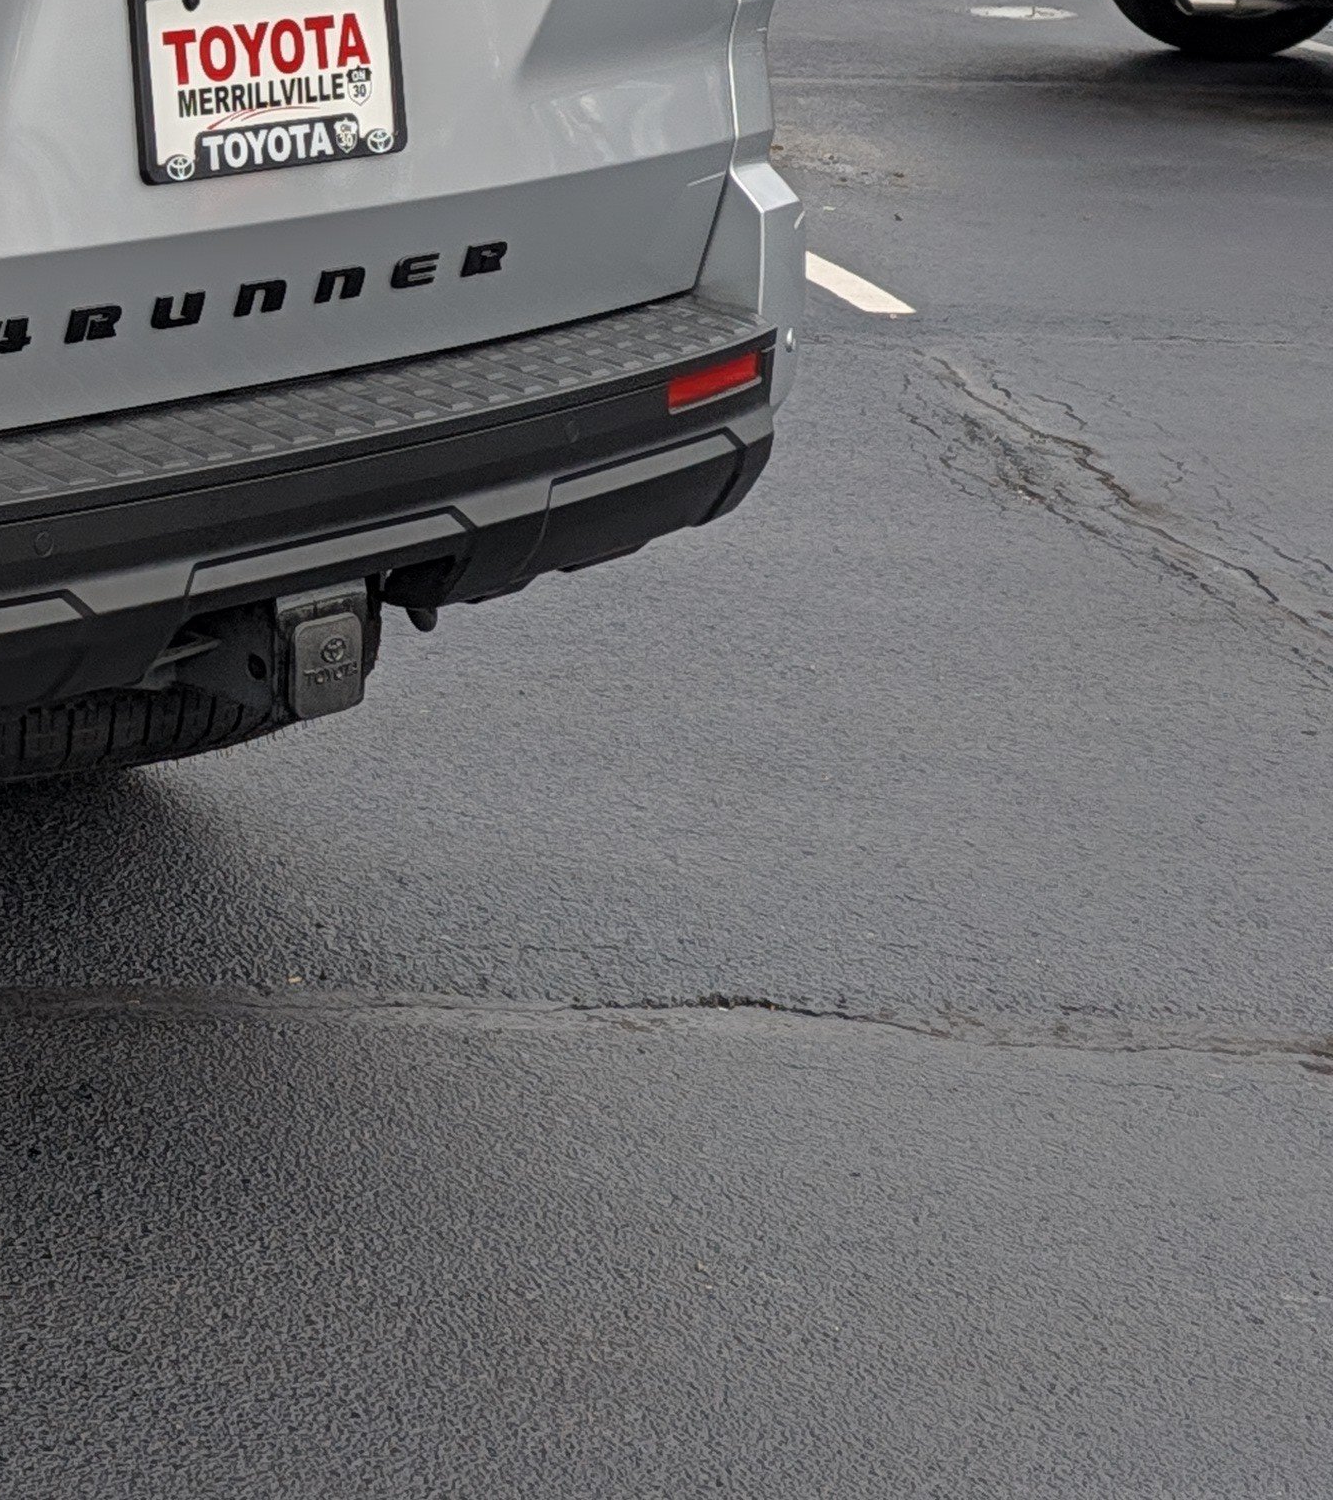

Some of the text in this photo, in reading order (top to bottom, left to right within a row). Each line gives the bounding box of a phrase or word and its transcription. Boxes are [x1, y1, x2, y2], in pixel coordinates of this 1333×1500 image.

[161, 12, 372, 86] TOYOTA
[177, 72, 346, 119] MERRILLVILLE
[352, 83, 367, 98] 30
[202, 121, 335, 172] TOYOTA
